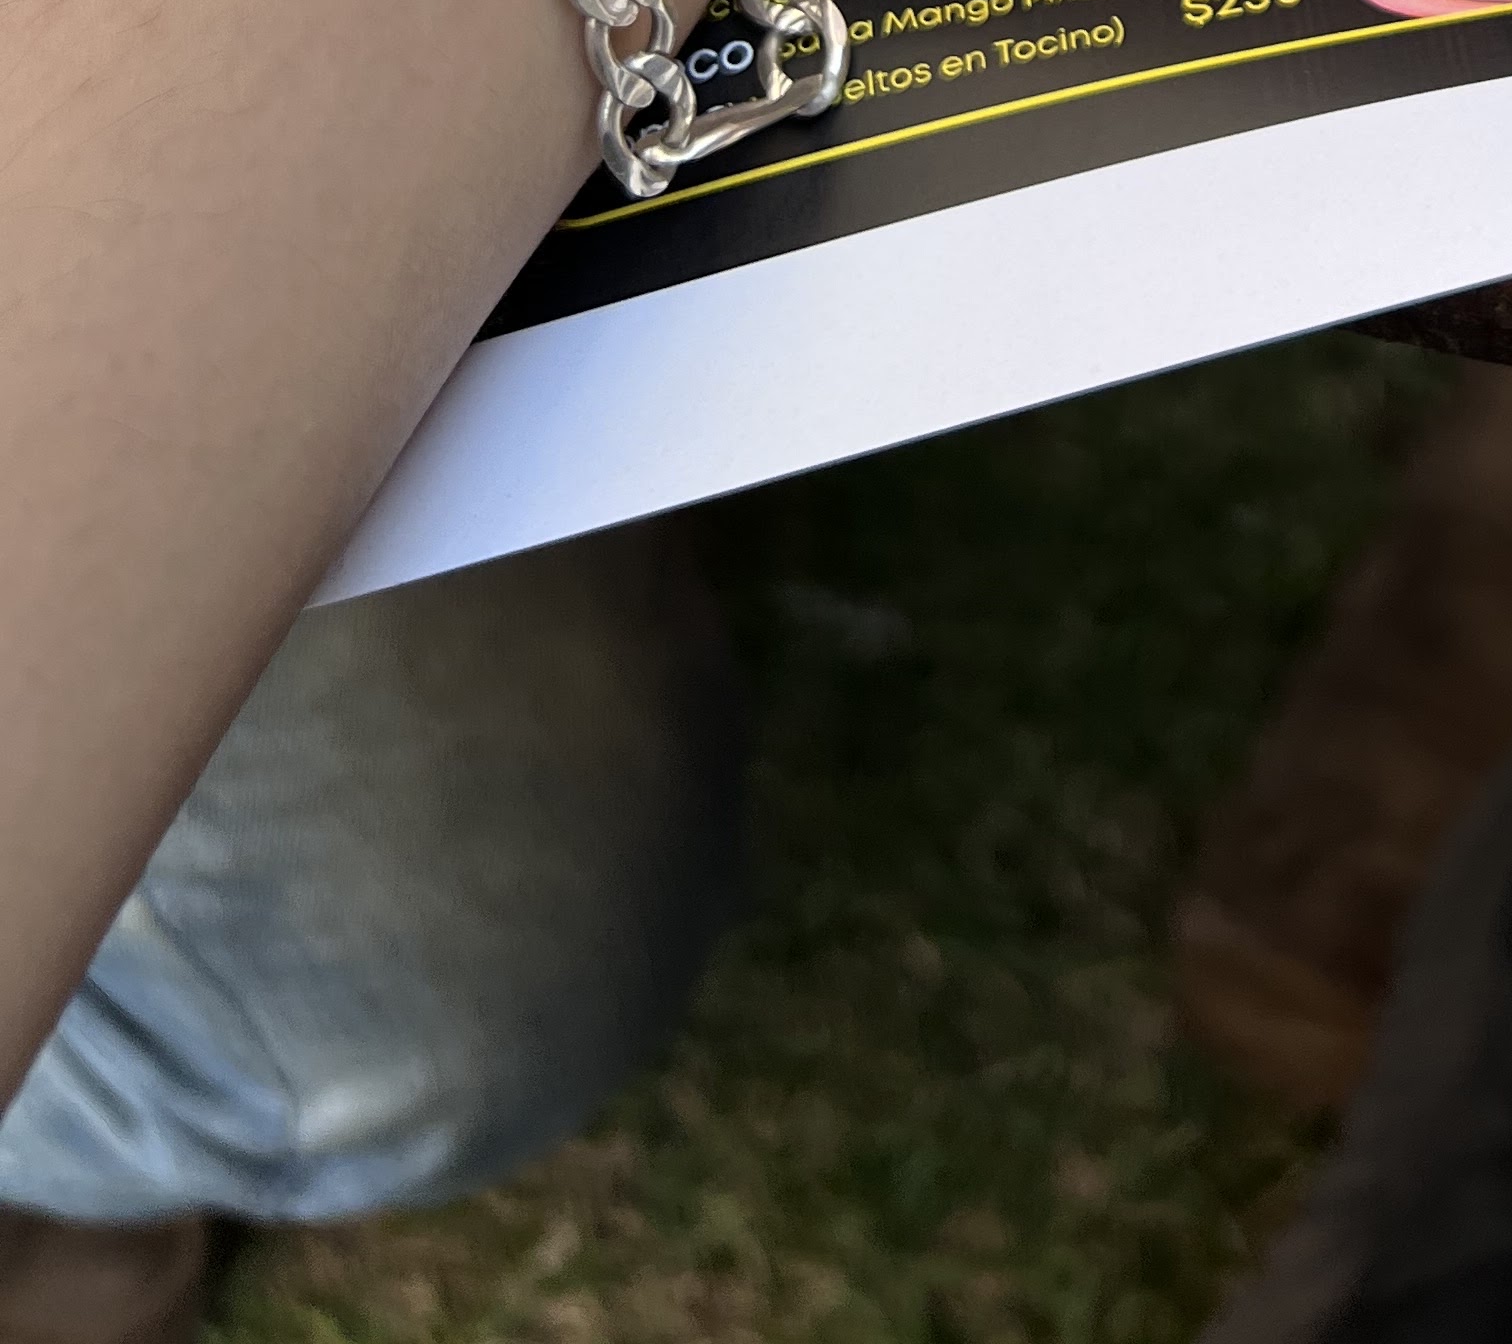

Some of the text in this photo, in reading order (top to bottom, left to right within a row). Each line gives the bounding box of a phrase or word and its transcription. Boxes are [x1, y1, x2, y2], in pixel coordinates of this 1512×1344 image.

[842, 60, 933, 106] eltos
[938, 48, 987, 82] en
[992, 14, 1126, 64] Tocino)
